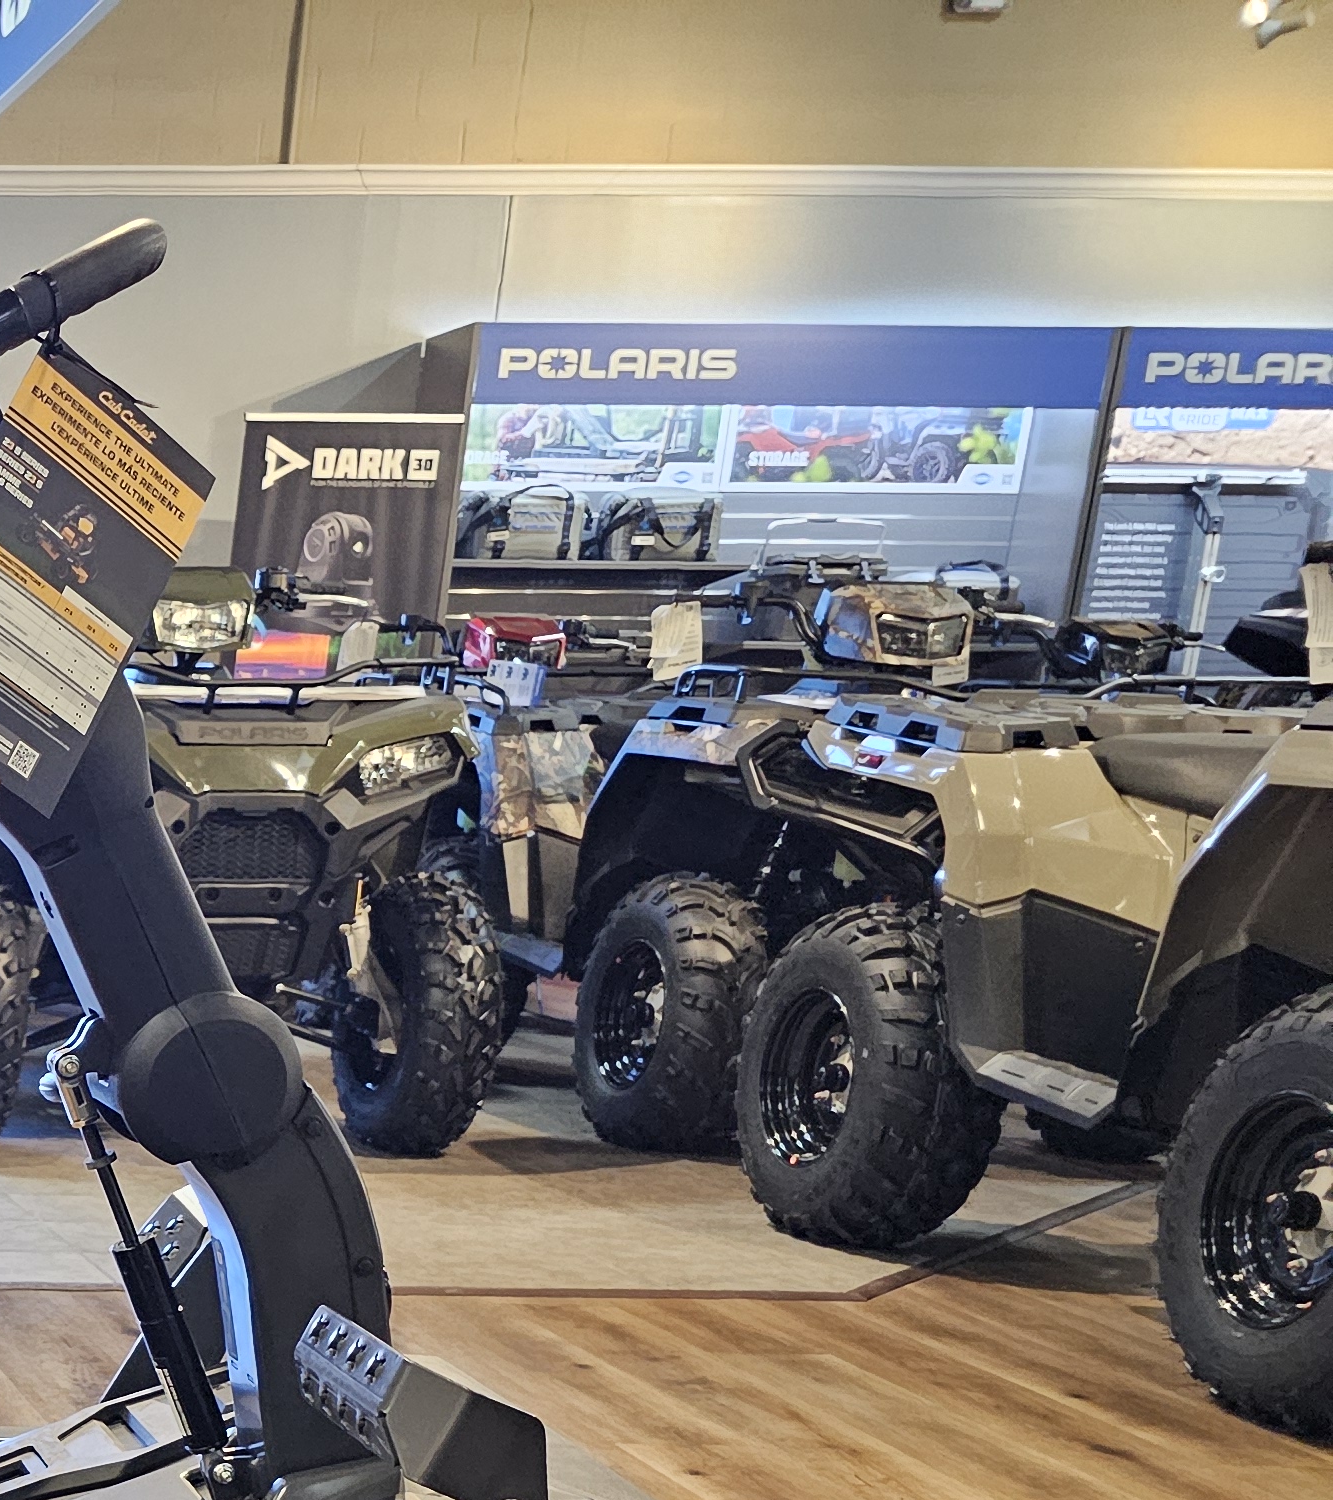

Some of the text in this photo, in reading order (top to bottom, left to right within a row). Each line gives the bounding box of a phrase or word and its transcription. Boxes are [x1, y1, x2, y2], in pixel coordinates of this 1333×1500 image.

[497, 348, 737, 380] POLARIS
[50, 381, 181, 498] EXPERIENCE THE ULTIMATE
[120, 409, 157, 445] Cadet
[31, 385, 186, 522] EXPERIMENTE LO MÁS RECIENTE
[50, 421, 156, 515] L'EXPÉRIENCE ULTIME
[312, 447, 406, 479] DARK
[748, 451, 810, 467] STORAGE
